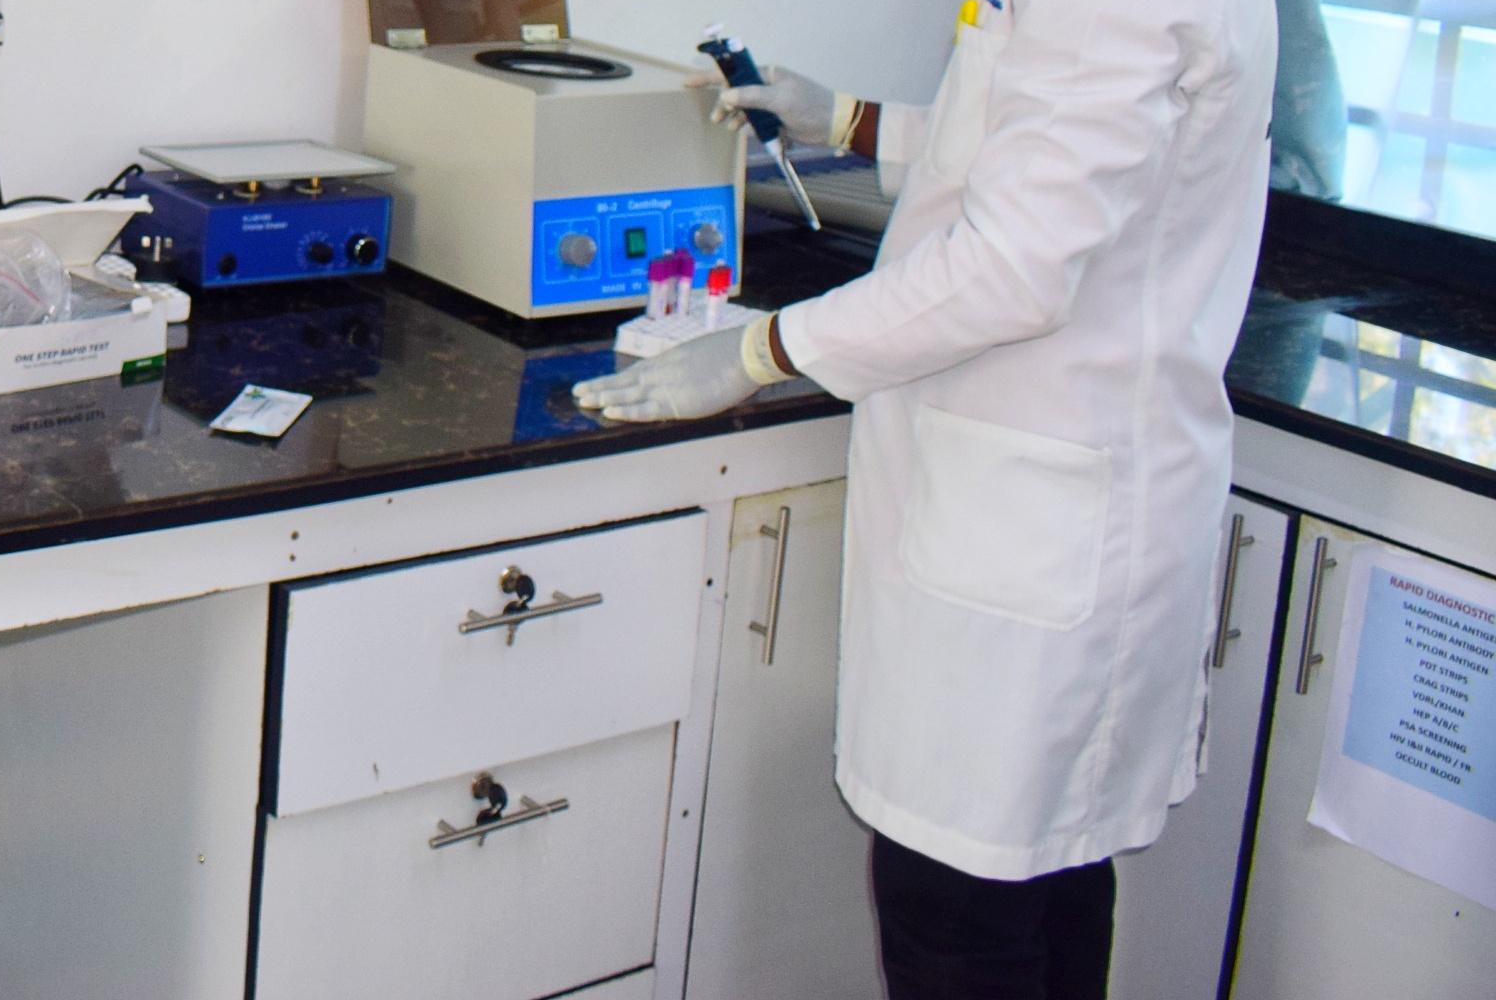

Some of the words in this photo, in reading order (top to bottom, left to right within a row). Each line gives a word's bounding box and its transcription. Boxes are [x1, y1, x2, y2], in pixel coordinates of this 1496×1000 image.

[14, 353, 34, 363] ONE
[37, 350, 58, 361] STEP
[60, 346, 87, 357] RAPID
[89, 341, 110, 353] TEST
[1390, 576, 1424, 597] RAPID
[1426, 590, 1495, 624] DIAGNOSTIC
[1403, 601, 1460, 630] SALMONELLA
[1462, 623, 1496, 644] ANTIGE
[1416, 623, 1447, 641] PYLORI
[1449, 636, 1495, 660] ANTIBODY
[1416, 641, 1448, 658] PYLORI
[1449, 654, 1489, 676] ANTIGEN
[1439, 667, 1469, 685] STRIPS
[1440, 684, 1469, 702] STRIPS
[1413, 708, 1431, 720] HEP
[1389, 732, 1405, 744] HIV
[1425, 746, 1452, 764] RAPID
[1399, 719, 1416, 732] PSA
[1418, 727, 1467, 754] SCREENING
[1395, 751, 1428, 770] OCCULT
[1430, 766, 1461, 785] BLOOD
